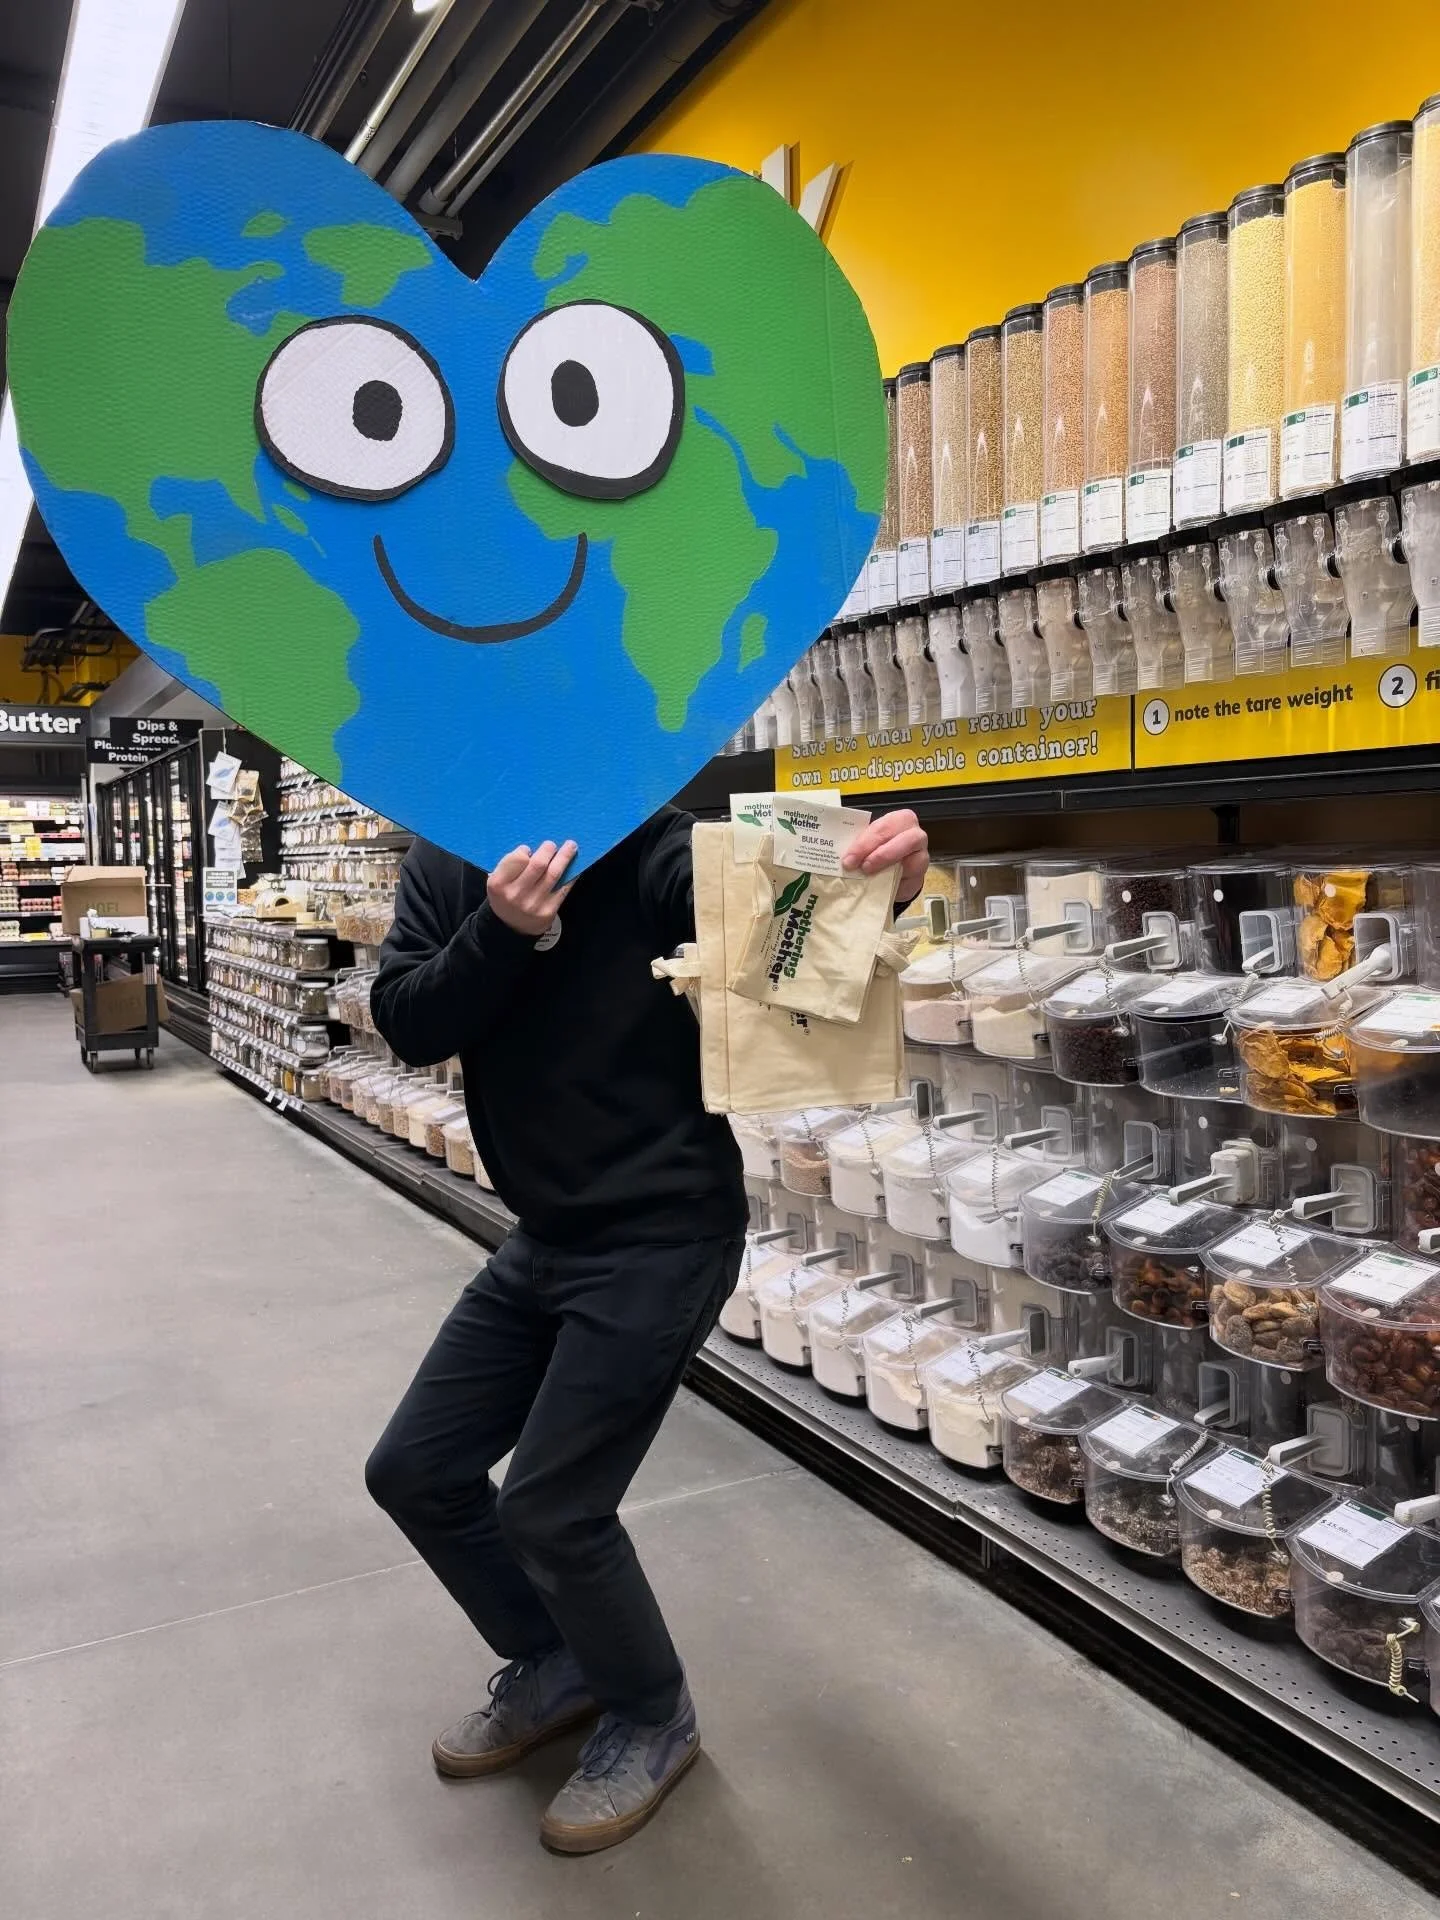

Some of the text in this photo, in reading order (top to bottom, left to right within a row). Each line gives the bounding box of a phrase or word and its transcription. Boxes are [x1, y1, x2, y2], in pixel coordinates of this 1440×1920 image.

[1174, 704, 1209, 721] note
[1214, 699, 1241, 717] the
[1245, 696, 1282, 712] tare
[1287, 683, 1354, 708] weight
[0, 709, 81, 734] Butter
[137, 720, 178, 733] Dips &
[792, 741, 826, 759] Save
[835, 736, 858, 753] 5%
[866, 727, 912, 748] when
[922, 718, 958, 746] you
[1039, 698, 1097, 731] your
[792, 729, 1099, 788] own non-disposable container!
[753, 809, 772, 818] Mot
[783, 809, 818, 822] mothering
[801, 835, 834, 848] BULK BAG
[783, 894, 819, 979] mothering
